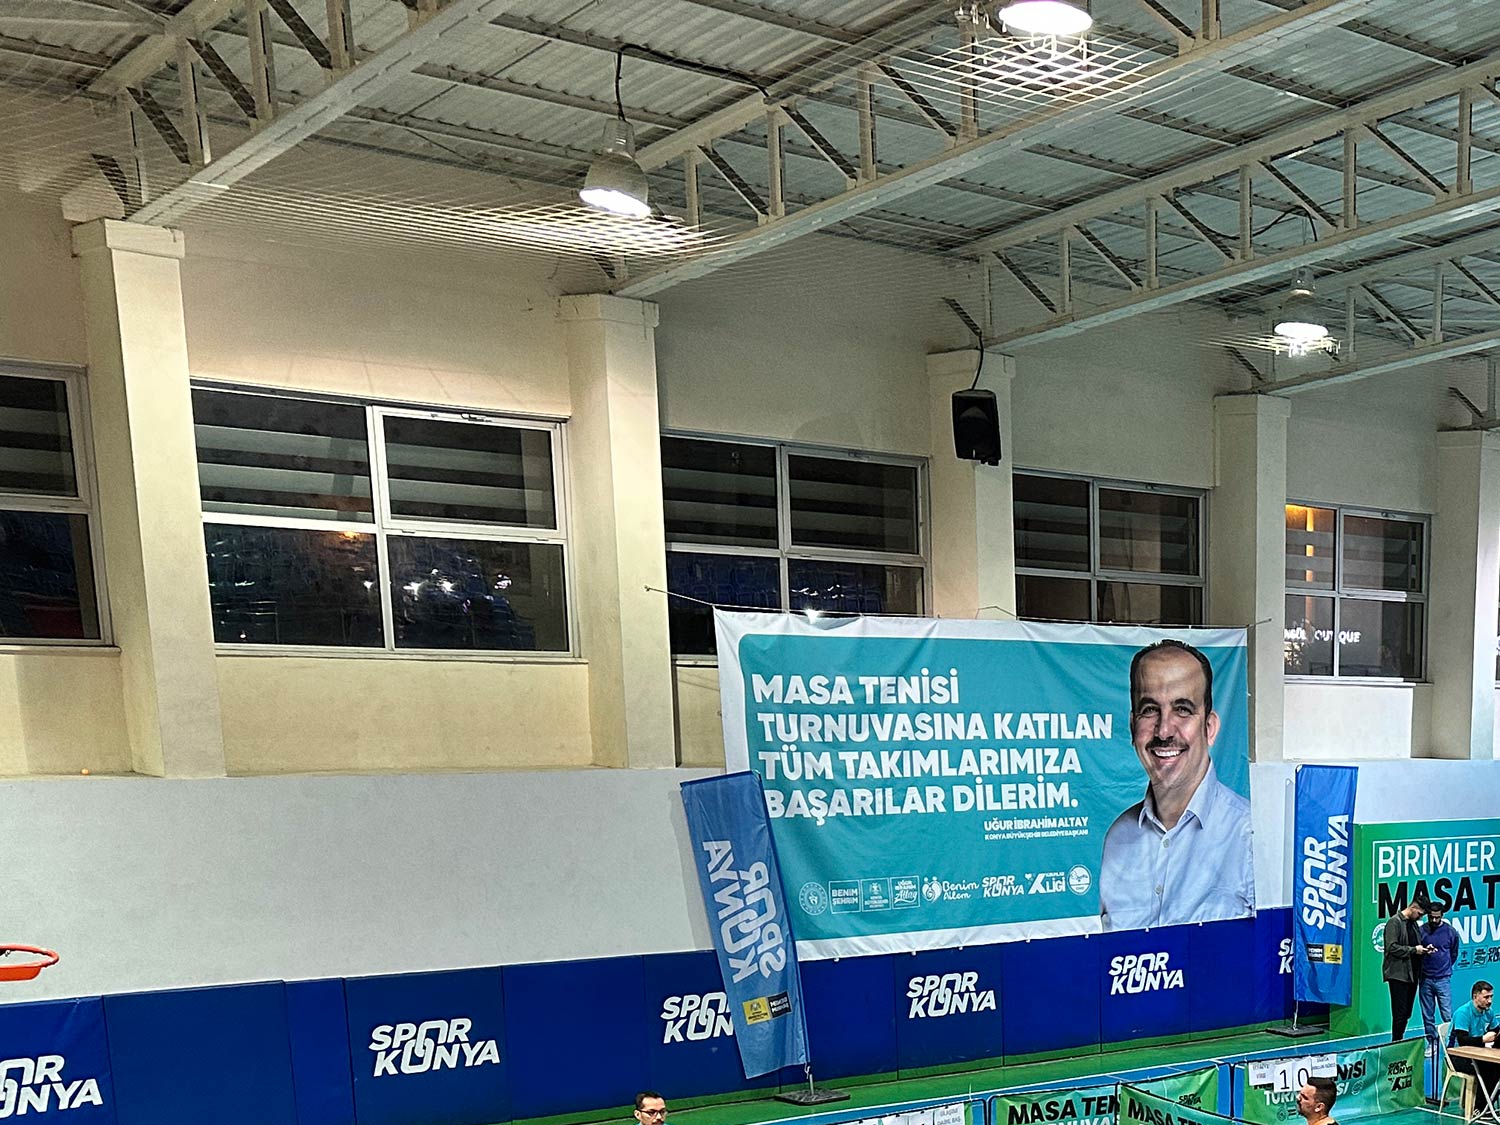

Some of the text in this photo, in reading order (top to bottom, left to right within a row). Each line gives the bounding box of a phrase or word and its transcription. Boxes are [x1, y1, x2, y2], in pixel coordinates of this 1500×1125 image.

[752, 668, 959, 705] MASA TENİSİ
[758, 712, 1112, 743] TURNUVASINA KATILAN
[758, 745, 1082, 781] TÜM TAKIMLARIMIZA
[766, 776, 1078, 826] BAŞARILAR DİLERİM.
[984, 815, 1089, 831] UĞUR İBRAHİM ALTAY
[1324, 814, 1350, 930] KONYA
[1378, 840, 1495, 879] BİRİMLER
[981, 875, 1015, 888] SPOR
[983, 882, 1025, 898] KONYA
[1302, 836, 1328, 930] SPOR
[1378, 876, 1477, 919] MASA
[1109, 951, 1169, 979] SPOR
[1110, 967, 1185, 995] KONYA
[906, 971, 979, 1006] SPOR
[908, 990, 997, 1019] KONYA
[369, 1017, 472, 1052] SPOR
[663, 1008, 734, 1043] KON
[373, 1040, 501, 1077] KONYA
[1278, 1069, 1290, 1091] 1
[1297, 1067, 1310, 1089] 0
[1008, 1101, 1077, 1125] MASA
